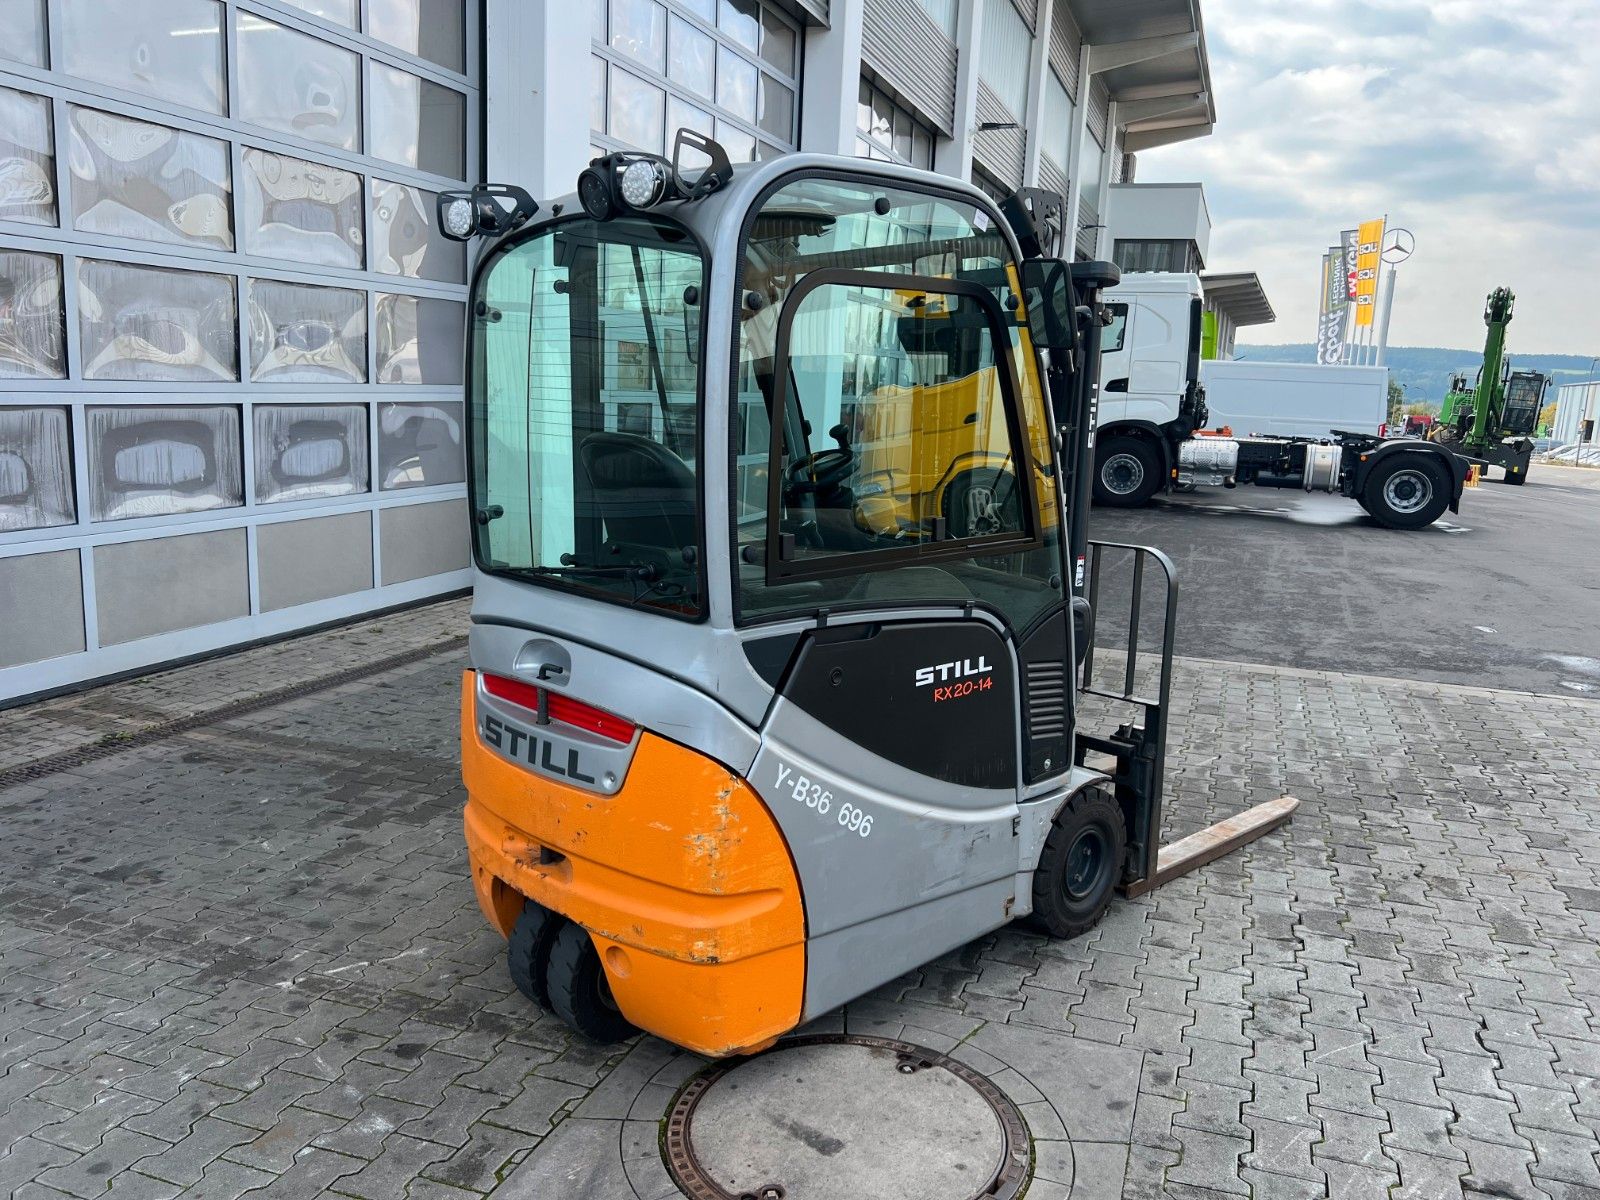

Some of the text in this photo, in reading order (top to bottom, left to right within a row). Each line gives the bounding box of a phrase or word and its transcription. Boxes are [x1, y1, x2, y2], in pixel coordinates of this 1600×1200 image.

[915, 655, 993, 687] STILL
[934, 676, 993, 703] RX20-14
[485, 714, 595, 785] STILL
[774, 762, 874, 838] Y-B36 696
